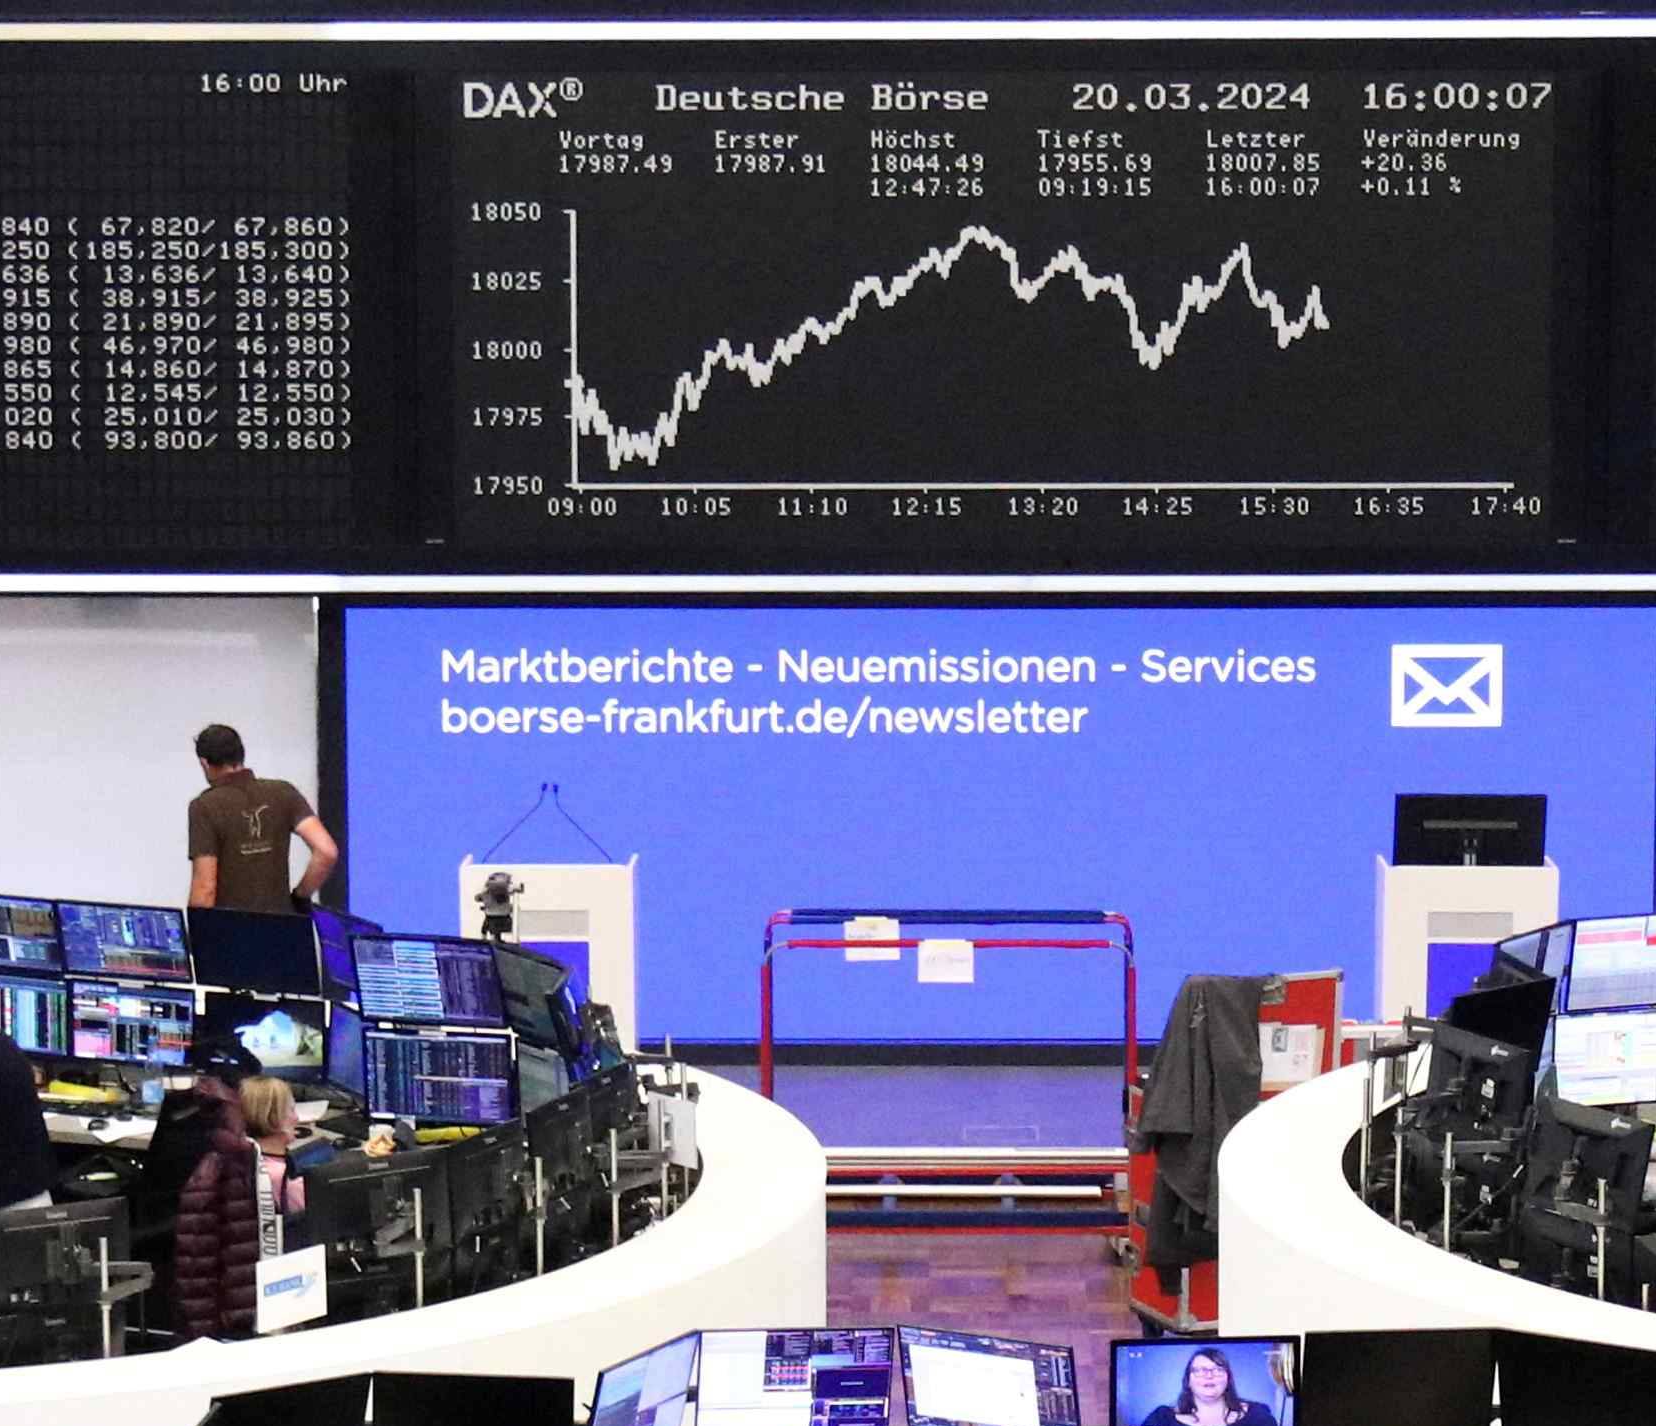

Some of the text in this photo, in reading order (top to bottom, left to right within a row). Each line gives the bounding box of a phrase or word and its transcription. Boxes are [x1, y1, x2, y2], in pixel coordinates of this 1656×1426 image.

[201, 72, 348, 93] 16:00 Uhr
[655, 81, 989, 111] Deutsche Börse
[1072, 82, 1311, 113] 20.03.2024
[1363, 82, 1552, 112] 16:00:07
[559, 129, 644, 152] Vortag
[714, 129, 799, 150] Erster
[870, 129, 955, 149] Höchst
[1036, 128, 1123, 149] Tiefst
[1206, 129, 1306, 149] Letzter
[1363, 128, 1520, 150] Veränderung
[559, 153, 673, 174] 17987.49
[715, 152, 826, 174] 17987.91
[870, 153, 984, 173] 18044.49
[1038, 152, 1152, 173] 17955.69
[1206, 152, 1320, 173] 18007.85
[1360, 152, 1447, 173] +20.36
[870, 176, 984, 198] 12:47:26
[1038, 176, 1152, 197] 09:19:15
[1206, 176, 1320, 197] 16:00:07
[1360, 176, 1462, 196] +0.11 %
[471, 201, 542, 222] 18050
[472, 270, 542, 291] 18025
[472, 340, 543, 360] 18000
[473, 406, 543, 427] 17975
[474, 475, 543, 495] 17950
[547, 496, 617, 517] 09:00
[661, 496, 731, 516] 10:05
[778, 496, 848, 516] 11:10
[892, 496, 962, 516] 12:15
[1008, 496, 1078, 516] 13:20
[1123, 496, 1193, 516] 14:25
[1240, 496, 1309, 516] 15:30
[1354, 496, 1424, 516] 16:35
[1471, 496, 1541, 516] 17:40
[441, 647, 1317, 684] Marktberichte - Neuemissionen - Services
[441, 695, 1089, 739] boerse-frankfurt.de/newsletter
